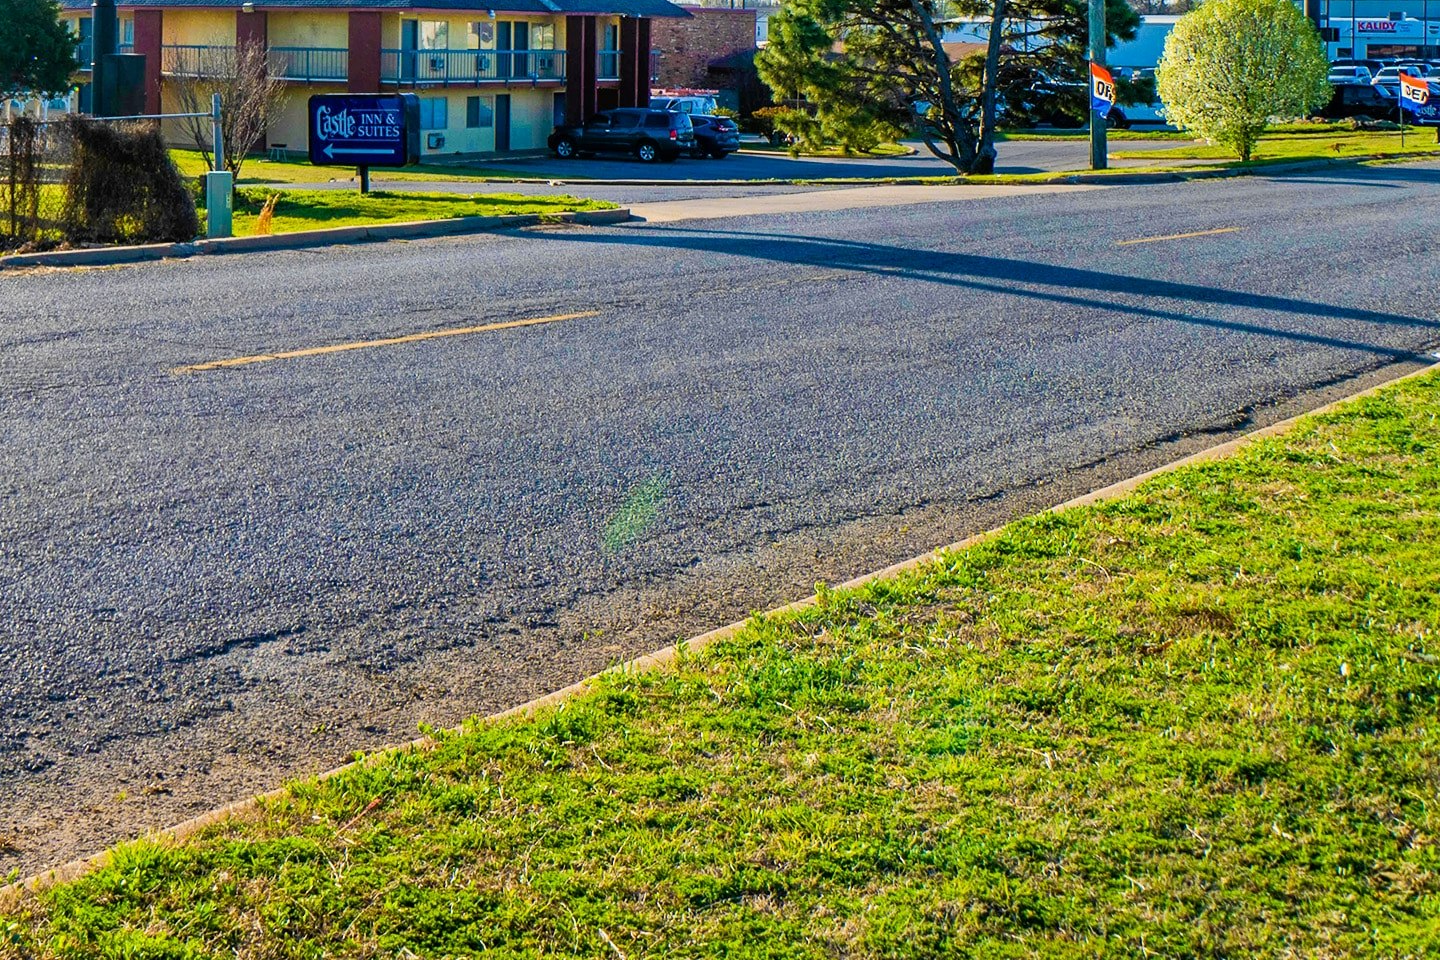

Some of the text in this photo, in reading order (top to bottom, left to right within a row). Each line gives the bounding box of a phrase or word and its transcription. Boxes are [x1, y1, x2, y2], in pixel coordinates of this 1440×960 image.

[317, 105, 356, 140] Castle
[361, 113, 396, 125] INN &
[358, 125, 400, 137] SUITES
